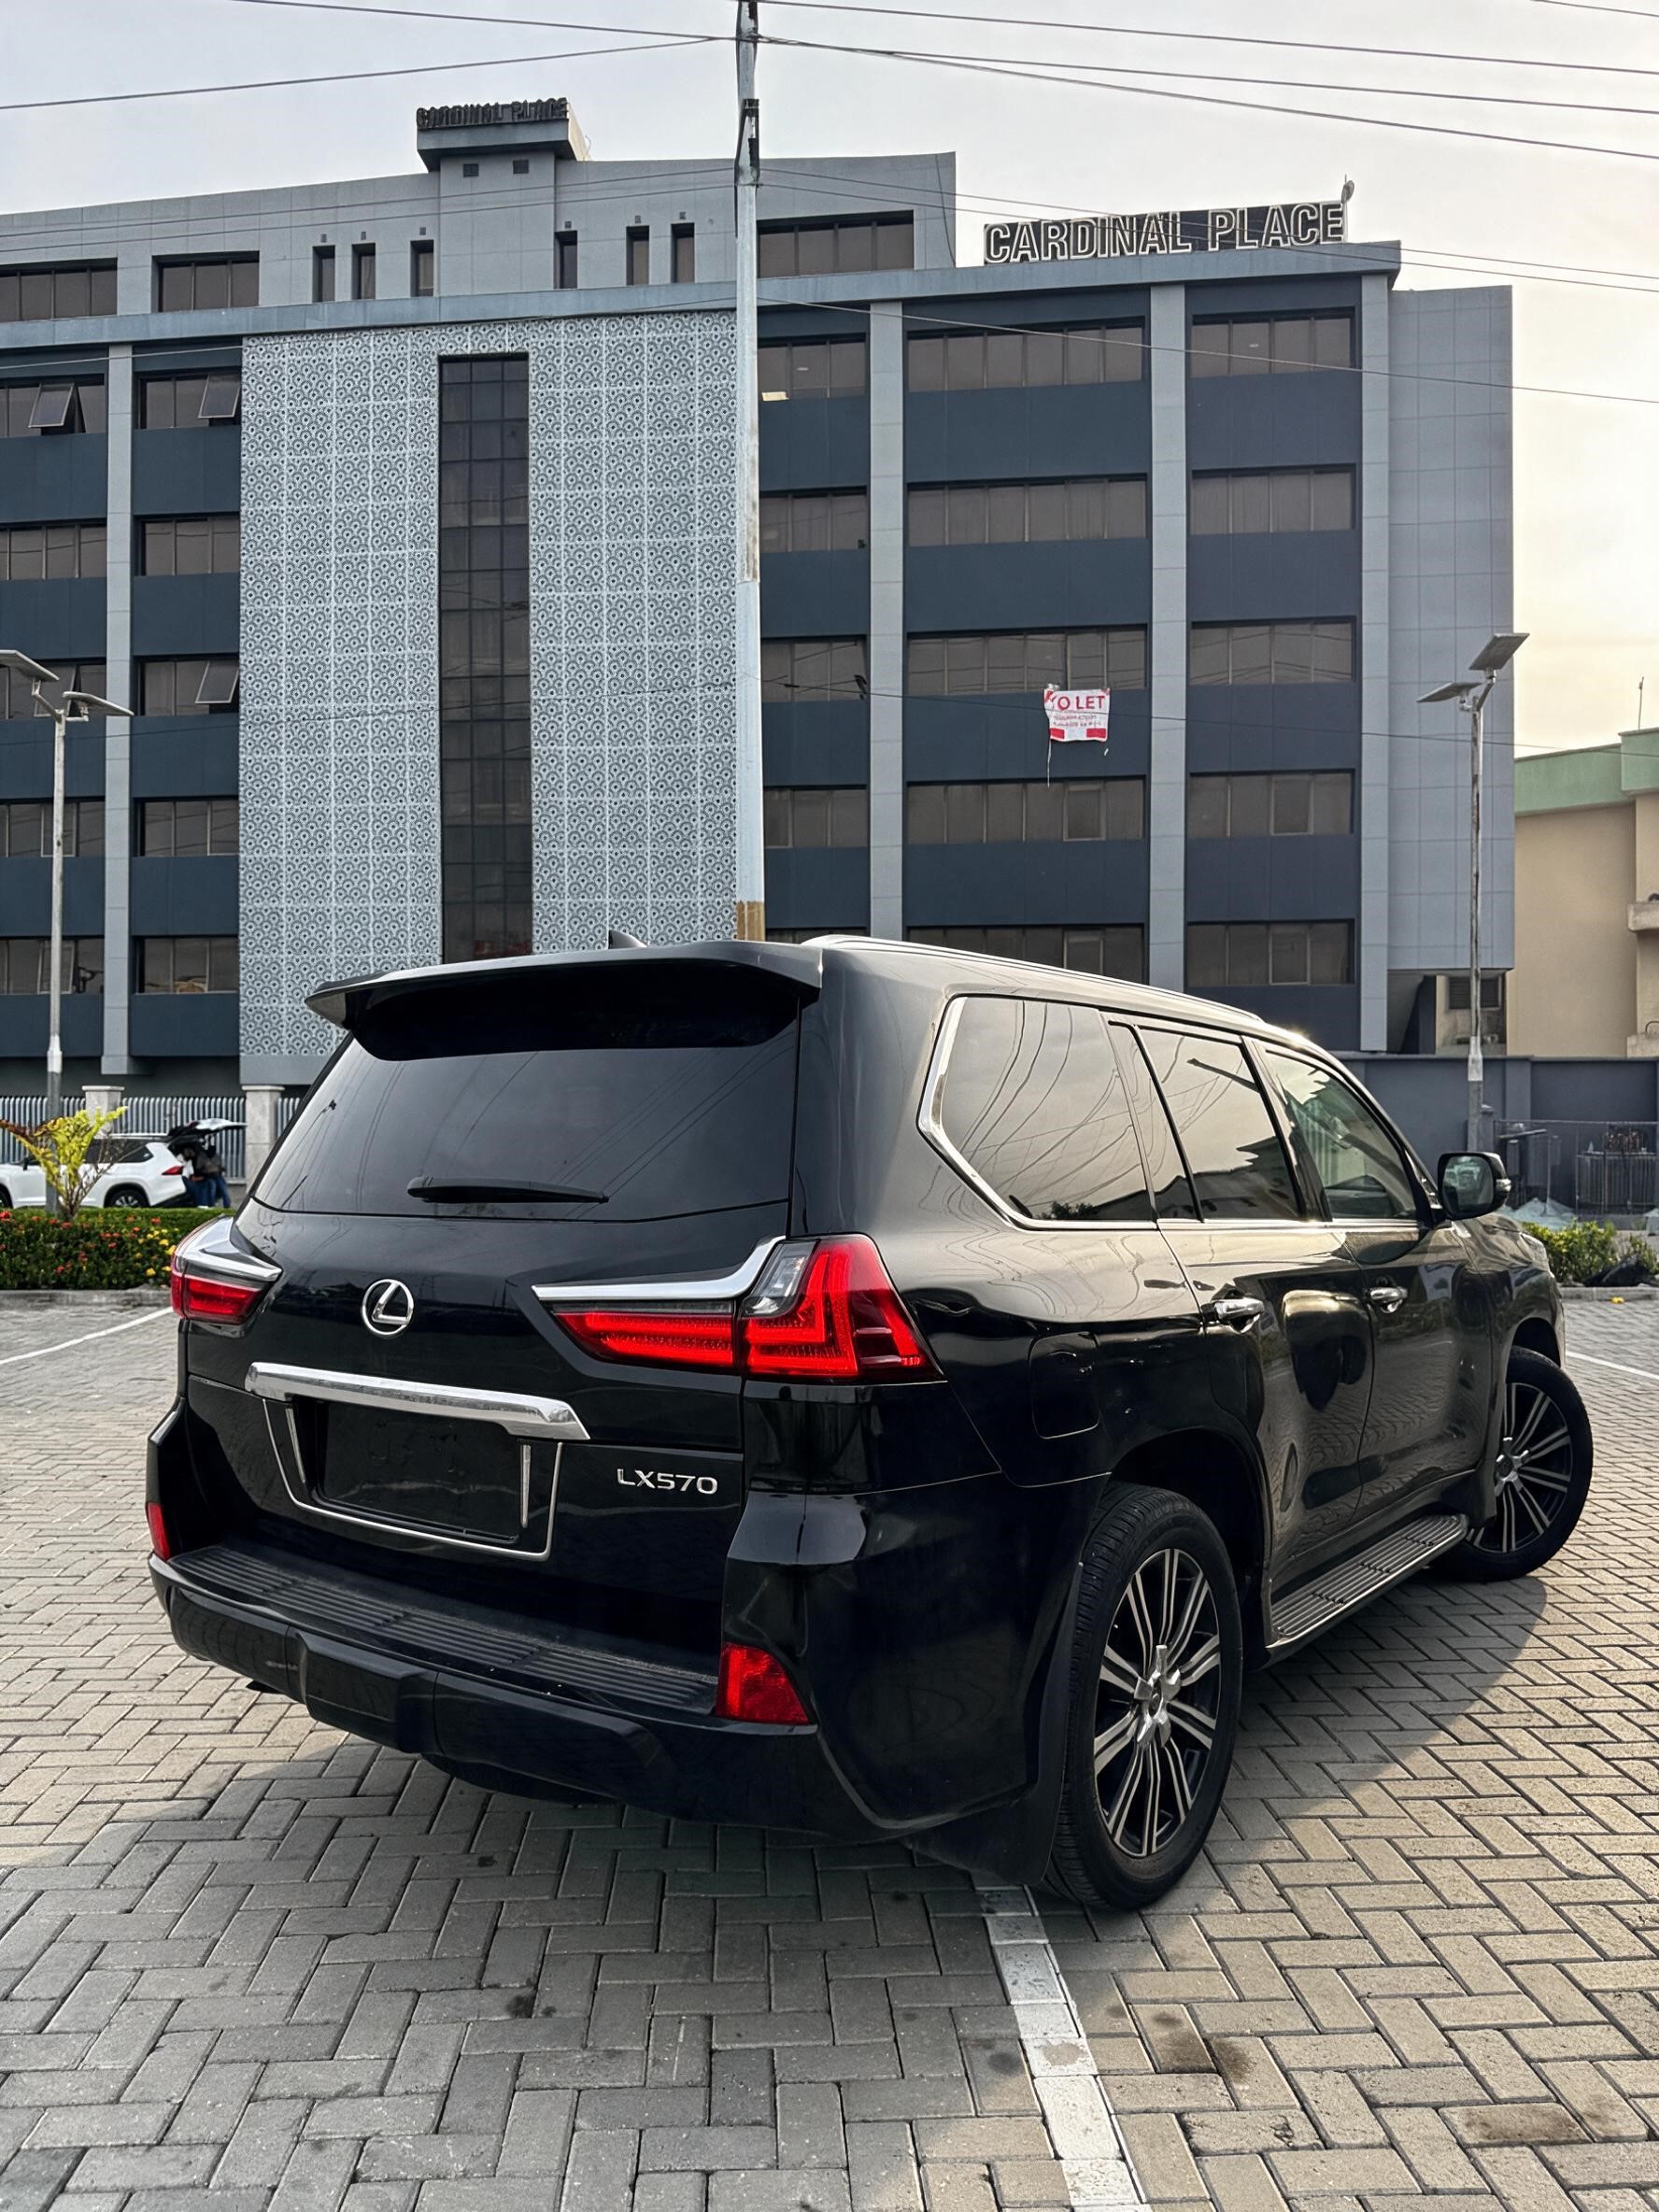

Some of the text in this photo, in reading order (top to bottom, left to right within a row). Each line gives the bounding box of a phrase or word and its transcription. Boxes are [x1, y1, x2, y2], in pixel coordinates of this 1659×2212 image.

[985, 202, 1344, 264] CARDINAL PLACE
[1076, 695, 1105, 709] LET
[617, 1468, 717, 1495] LX570
